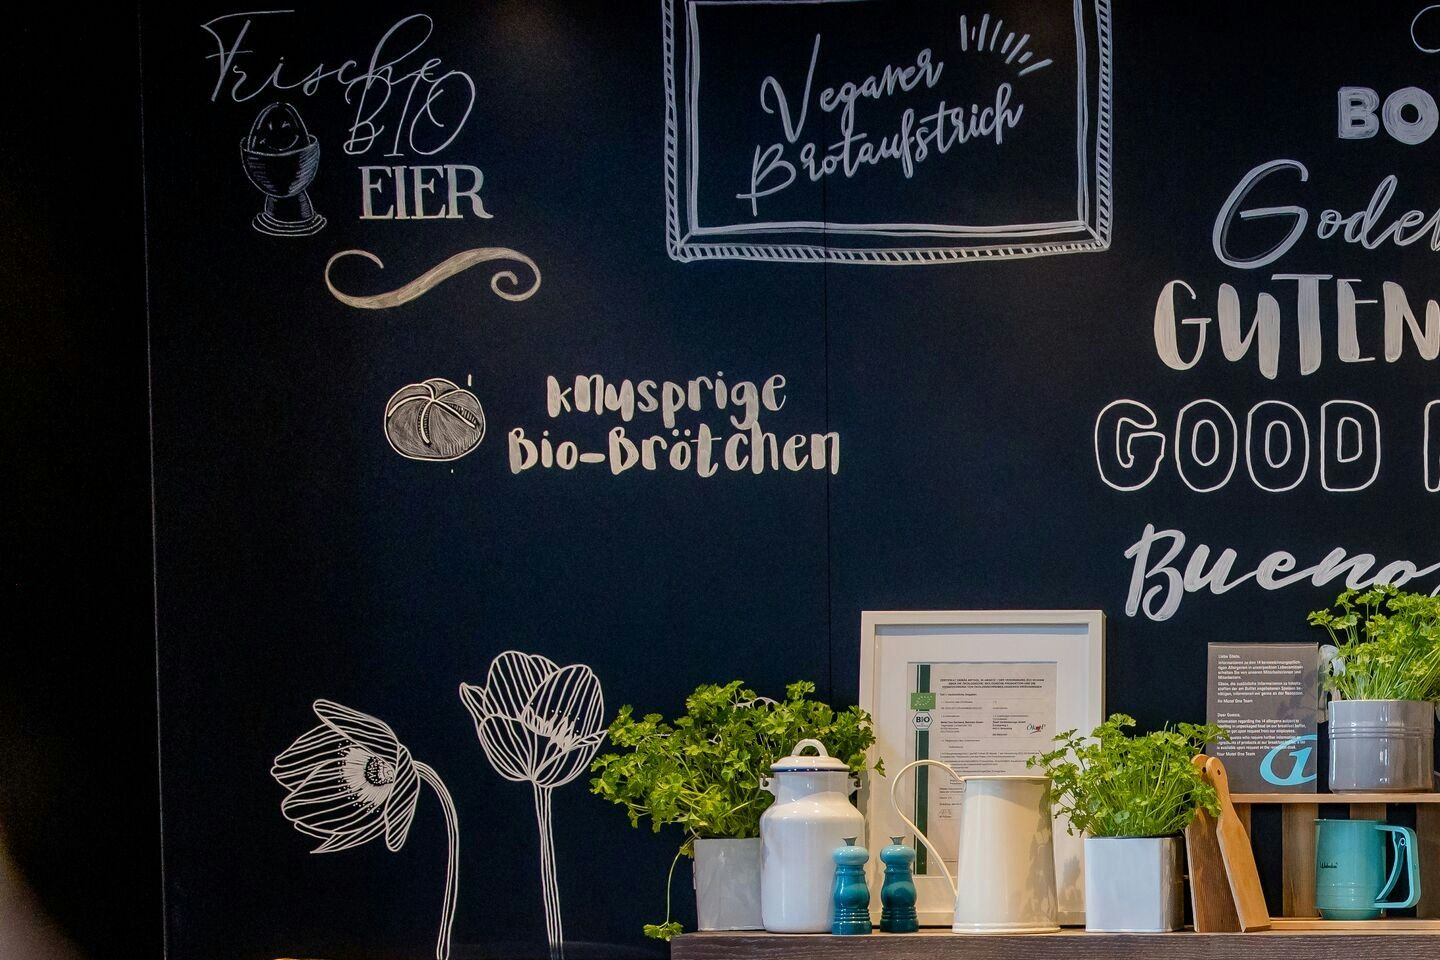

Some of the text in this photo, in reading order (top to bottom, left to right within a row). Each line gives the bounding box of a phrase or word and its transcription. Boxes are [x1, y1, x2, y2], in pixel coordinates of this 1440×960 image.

[200, 10, 454, 102] Frische
[760, 33, 944, 143] Veganer
[344, 71, 476, 156] BIO
[736, 83, 1024, 216] Brotaufstrich
[358, 164, 494, 219] EIER
[1153, 272, 1440, 380] GUTEN
[508, 420, 840, 478] Bio-Brötchen
[1094, 399, 1382, 494] GOOD
